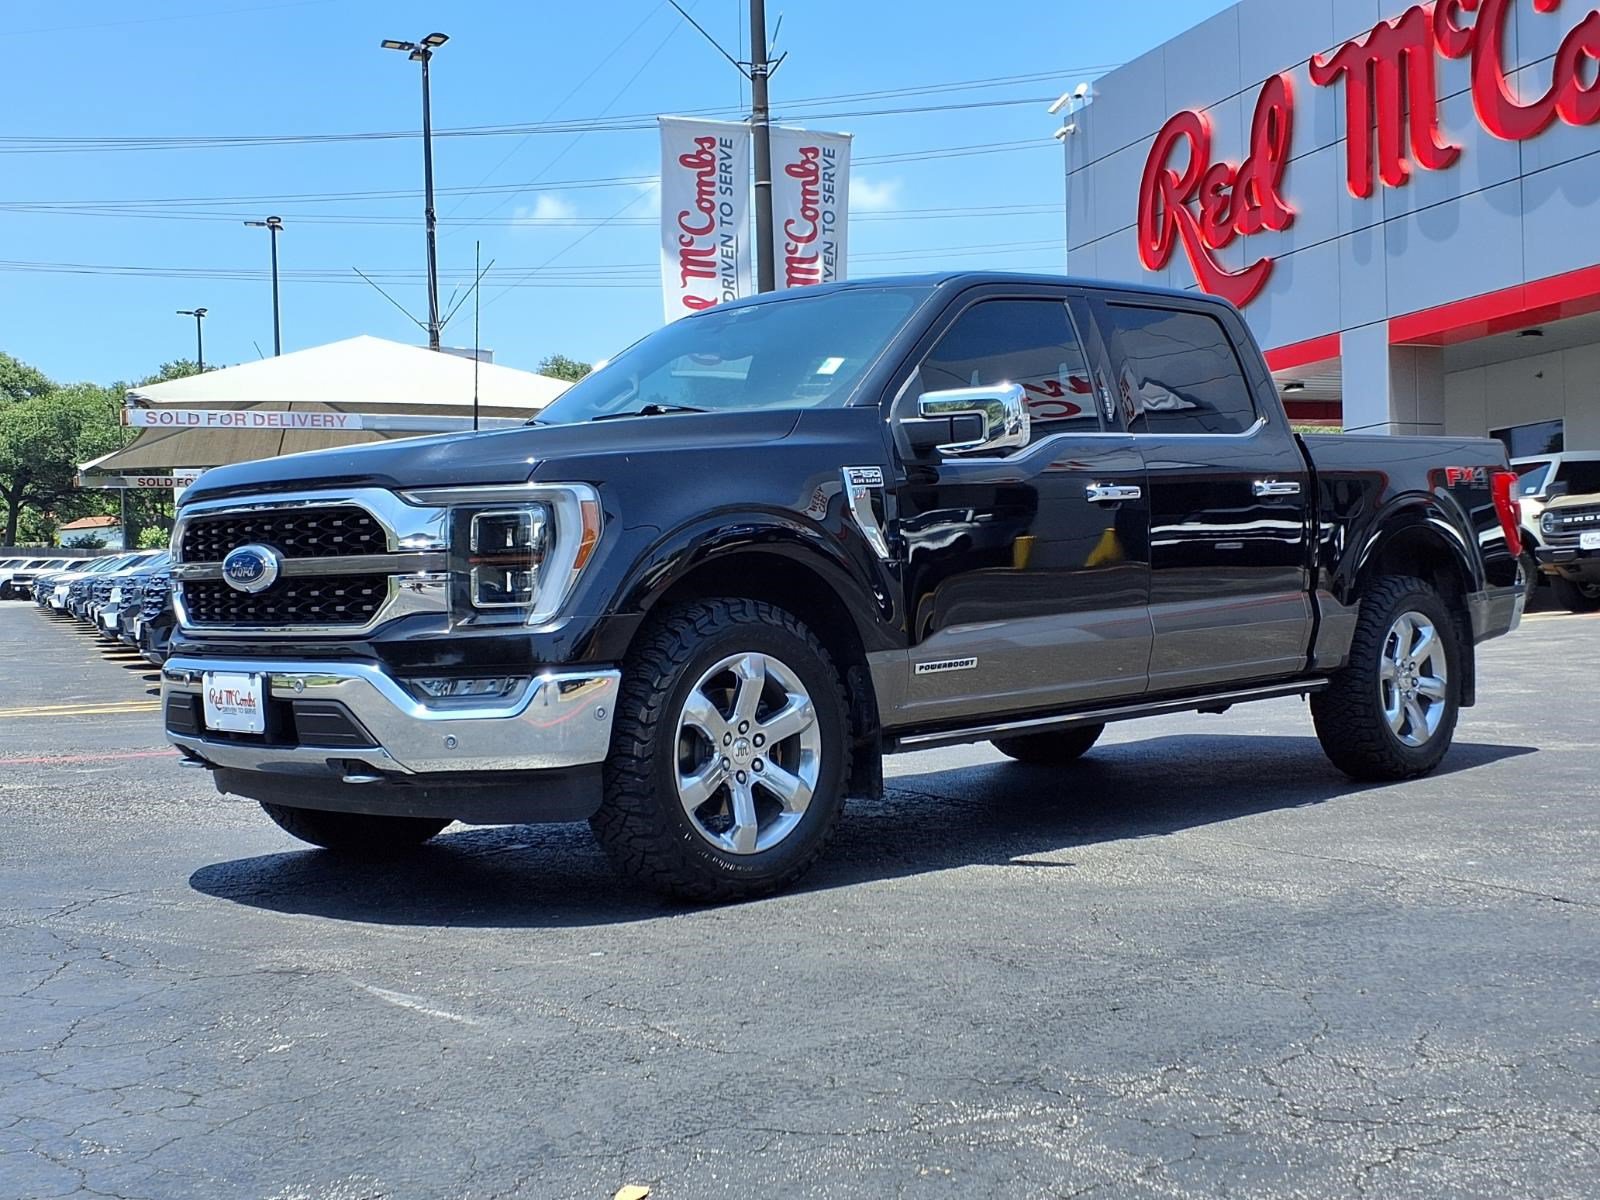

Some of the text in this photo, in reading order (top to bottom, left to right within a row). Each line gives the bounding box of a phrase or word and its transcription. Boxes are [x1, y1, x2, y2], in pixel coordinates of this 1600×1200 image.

[822, 147, 836, 205] SERVE
[1137, 73, 1297, 309] Red
[677, 136, 717, 288] McCombs
[719, 137, 736, 303] DRIVEN TO SERVE
[784, 147, 820, 288] McCombs
[822, 210, 835, 235] TO
[145, 411, 348, 428] SOLD FOR DELIVERY
[138, 477, 195, 487] SOLD FO
[1445, 466, 1486, 487] FX4
[230, 561, 256, 577] Ford
[918, 659, 975, 672] POWERBOOST
